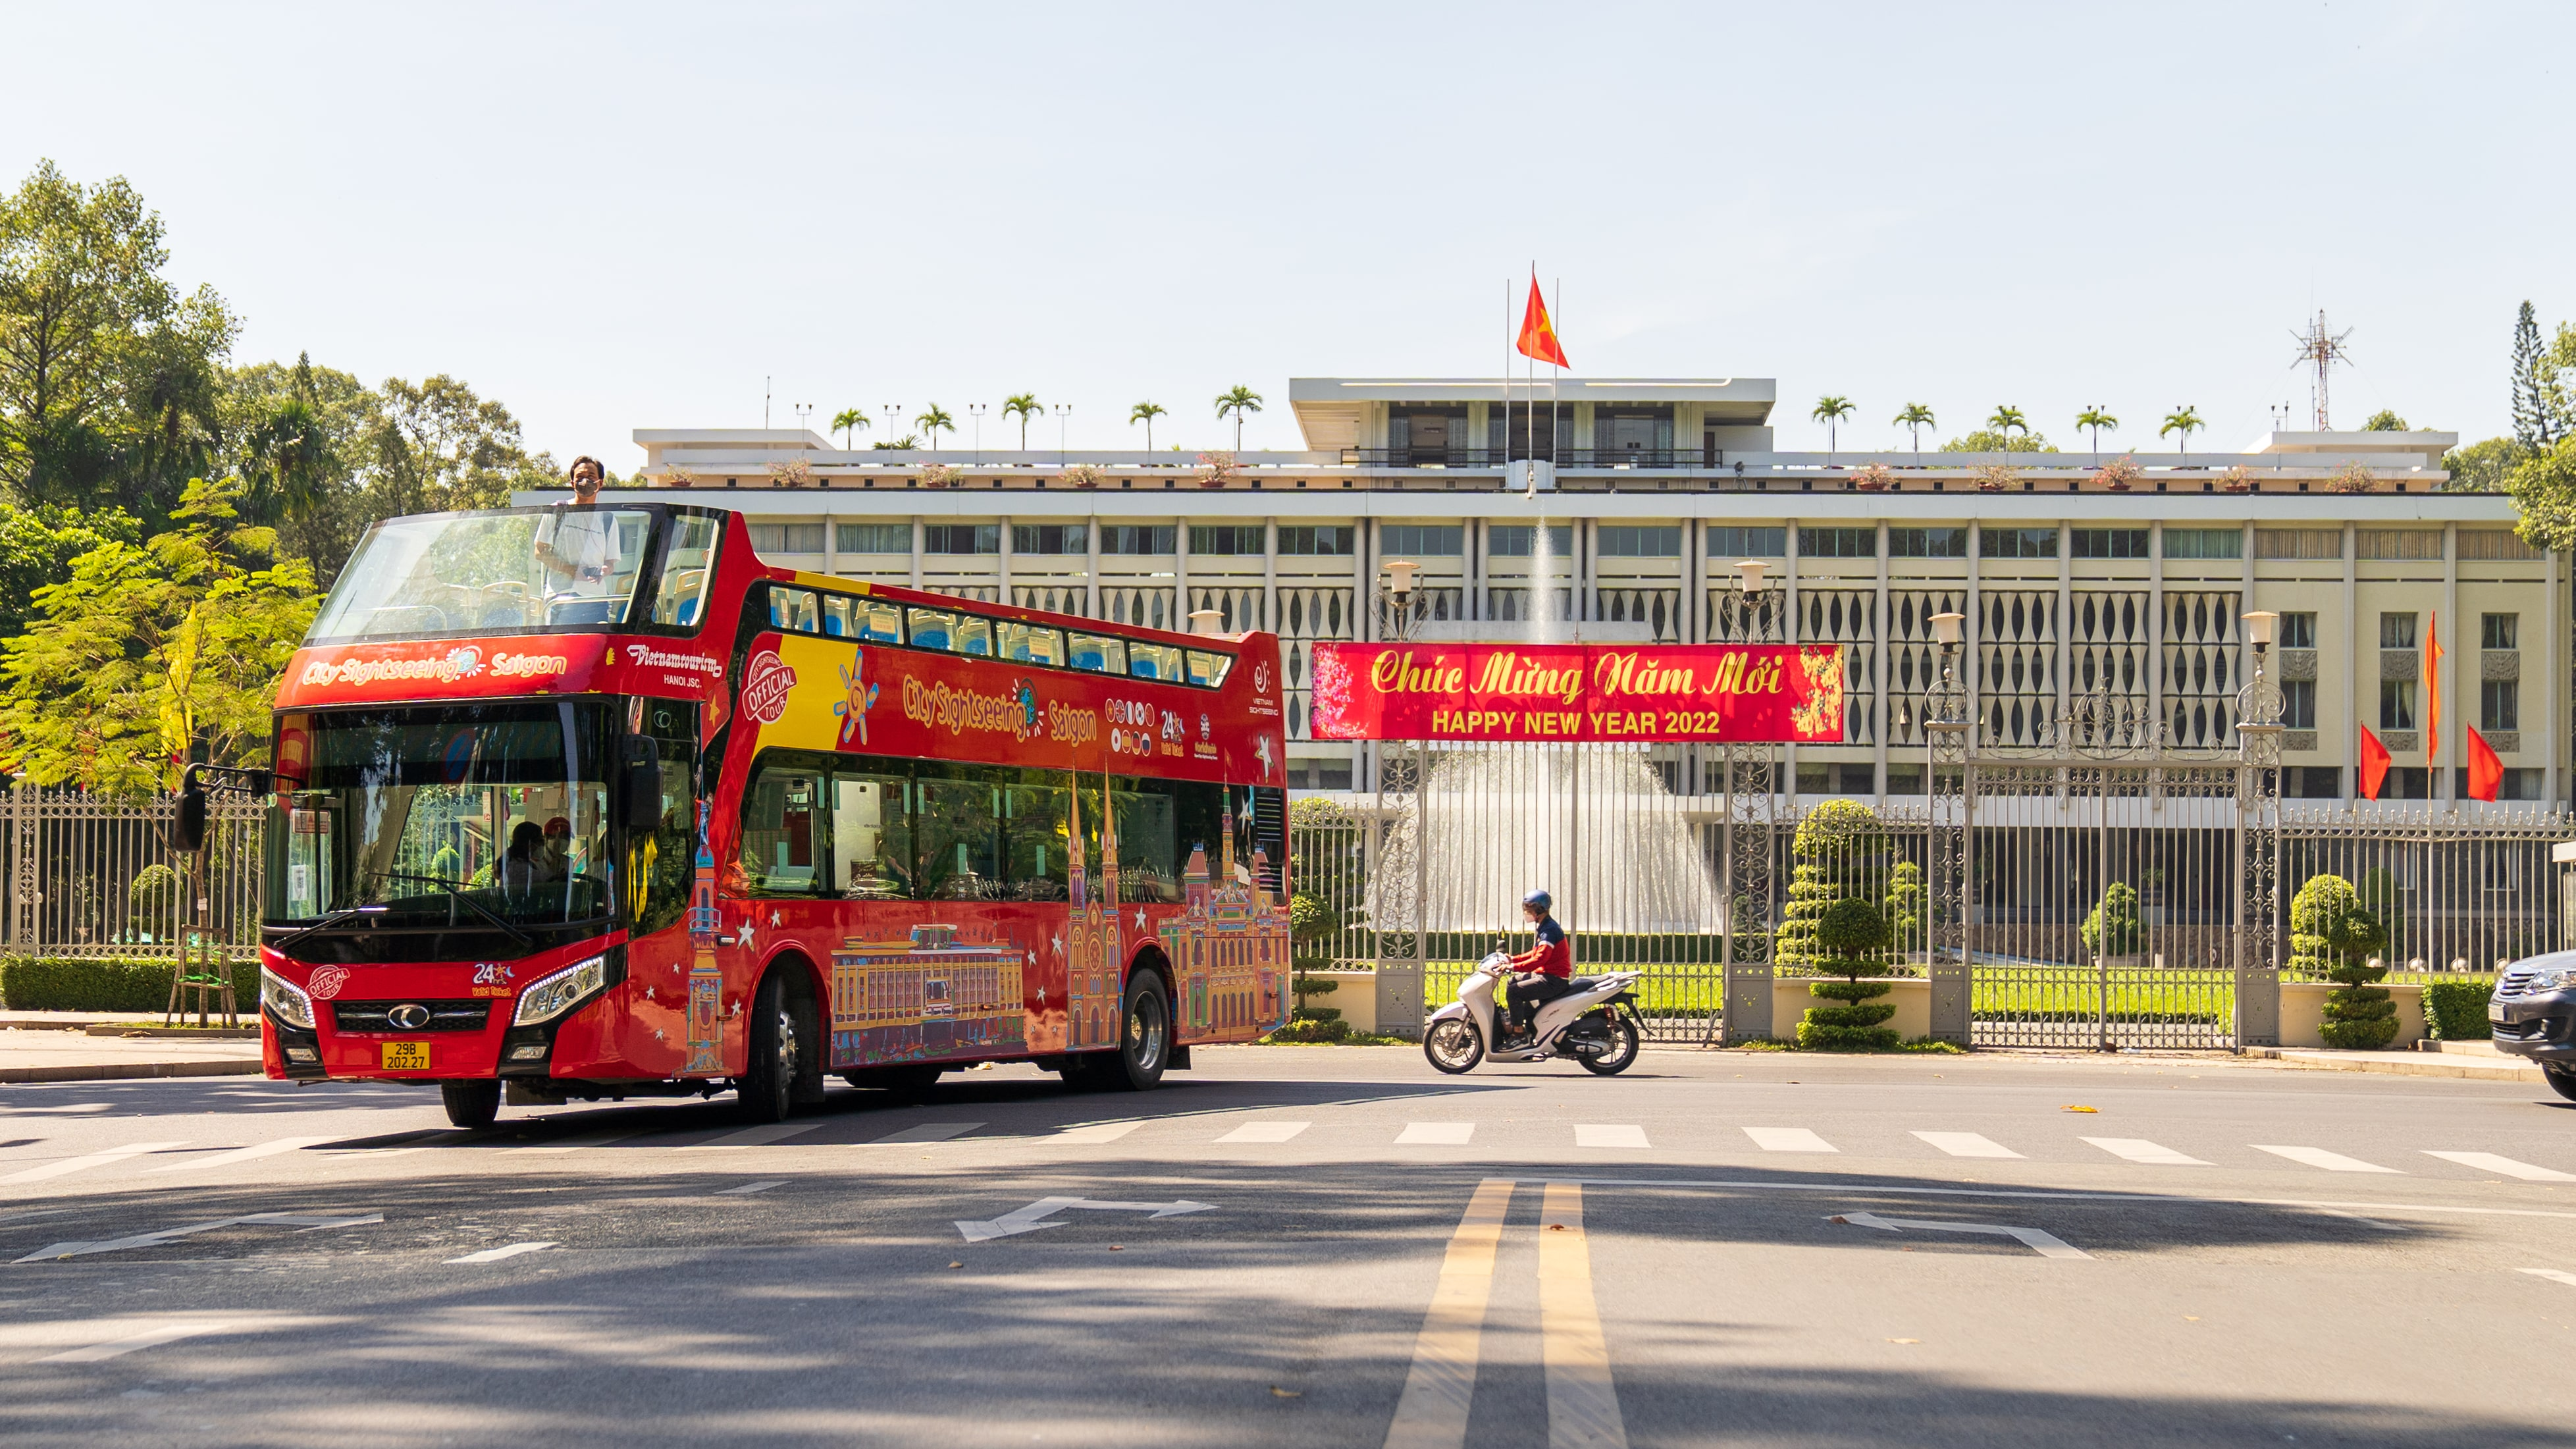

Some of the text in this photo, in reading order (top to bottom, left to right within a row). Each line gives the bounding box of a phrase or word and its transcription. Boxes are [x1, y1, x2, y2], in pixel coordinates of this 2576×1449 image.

[490, 652, 567, 678] Saigon
[626, 645, 722, 678] Vietnamtourism
[664, 674, 686, 687] HANOI
[1371, 650, 1783, 705] Chúc Mừng Năm Mới
[748, 669, 795, 711] OFFICIAL
[765, 696, 786, 718] TOUR
[1049, 699, 1097, 747] Saigon
[1161, 710, 1174, 740] 24
[1433, 711, 1720, 735] HAPPY NEW YEAR 2022
[309, 970, 348, 995] OFFICIAL
[473, 963, 494, 984] 24
[323, 984, 340, 996] TOUR
[396, 1043, 416, 1055] 29B
[387, 1057, 425, 1068] 202.27
